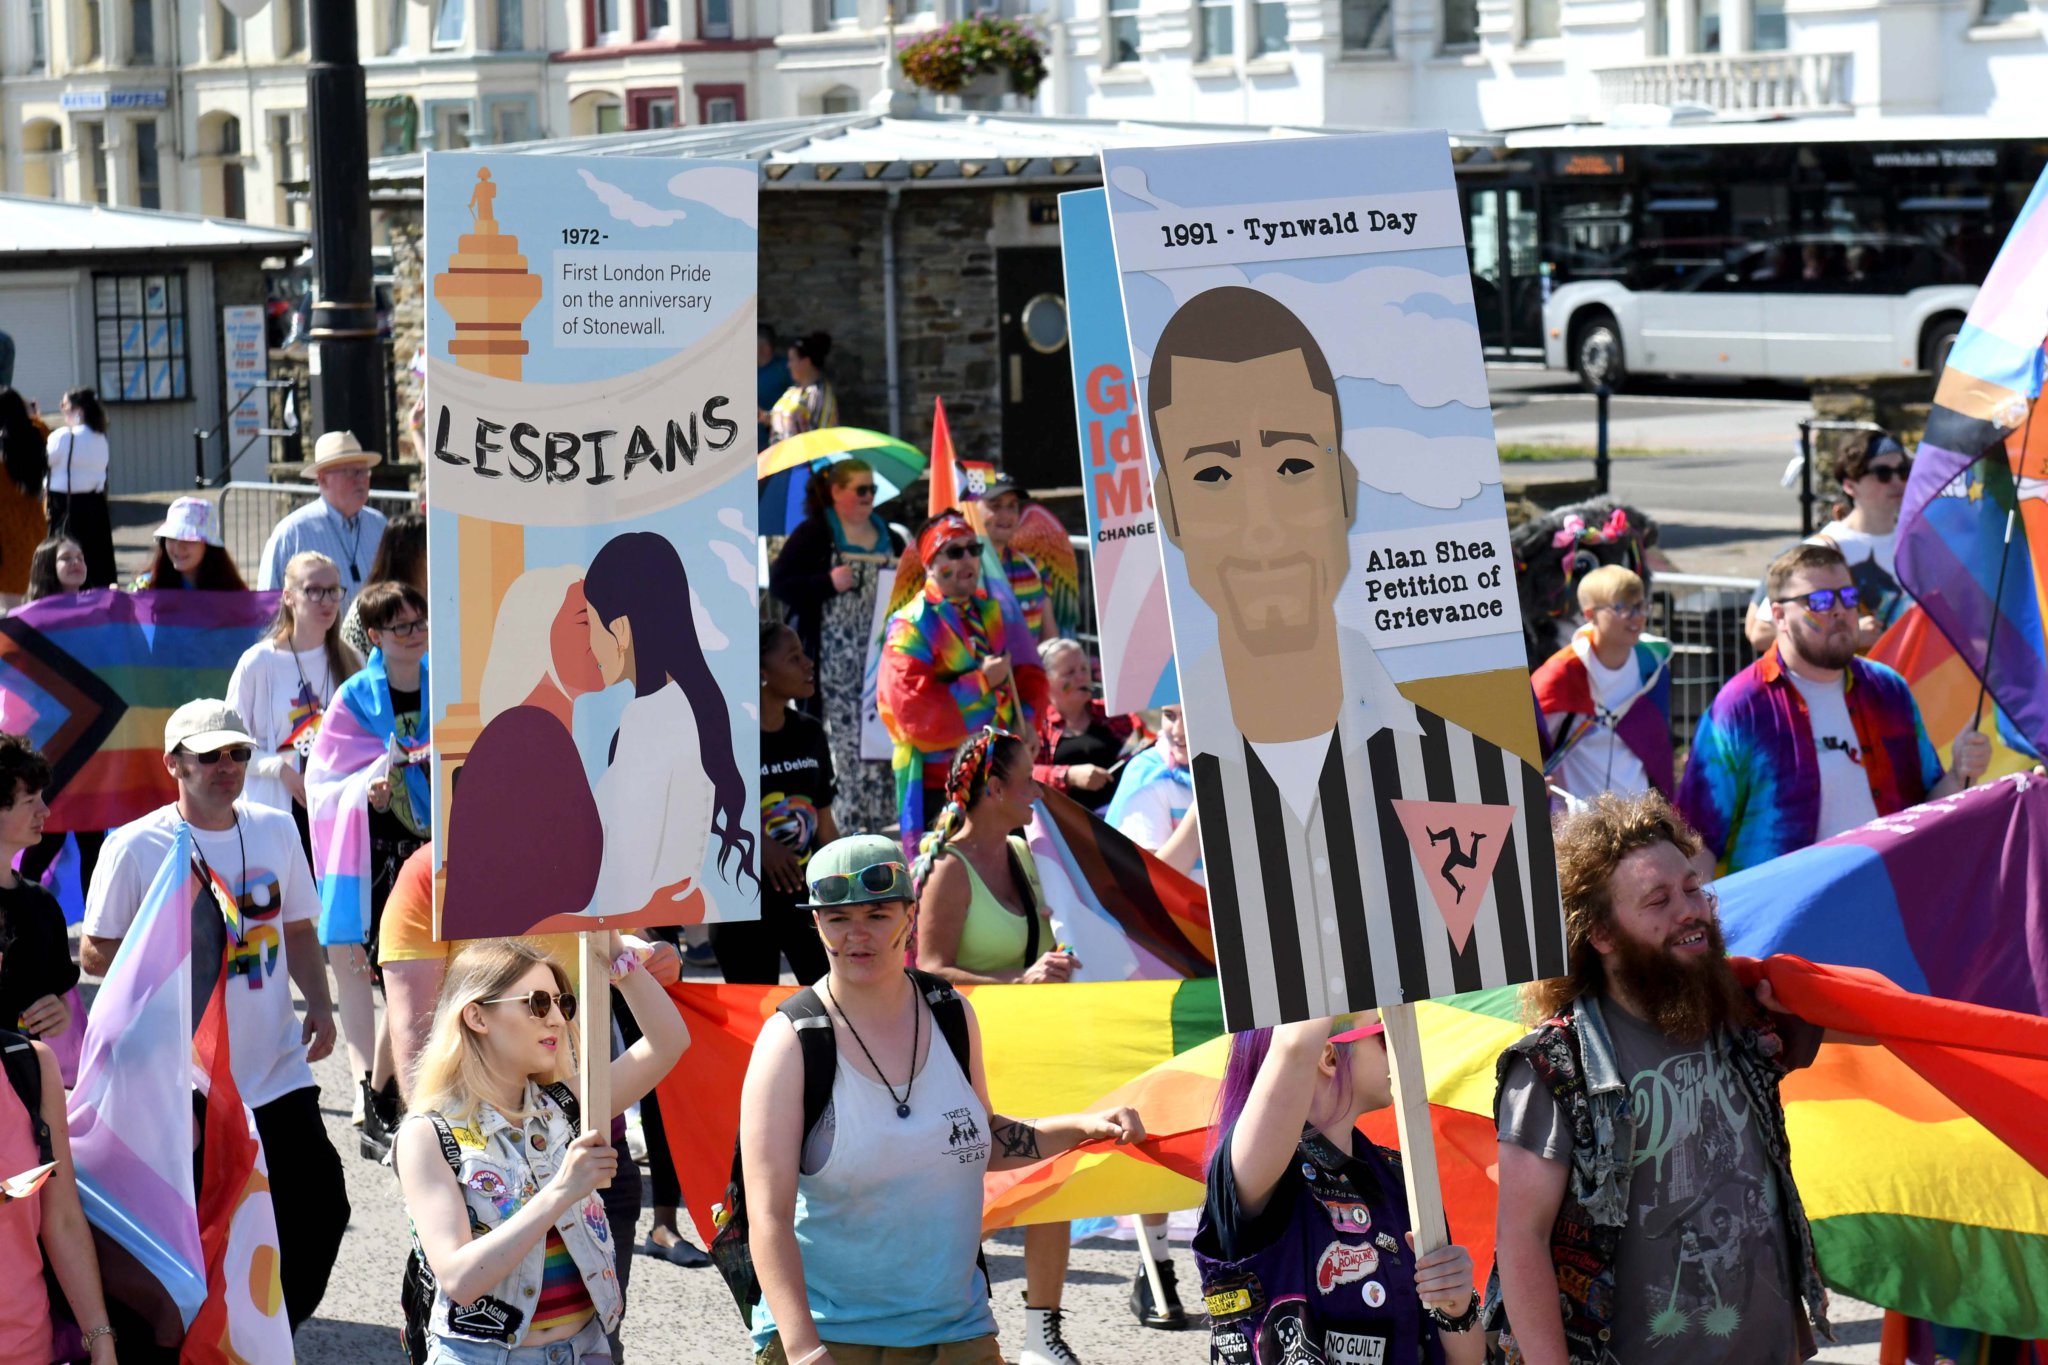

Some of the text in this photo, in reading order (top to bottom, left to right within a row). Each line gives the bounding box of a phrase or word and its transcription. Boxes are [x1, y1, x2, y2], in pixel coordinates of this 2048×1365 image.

[1161, 222, 1218, 247] 1991
[1244, 211, 1359, 246] Tynwald
[1367, 209, 1418, 235] Day
[562, 263, 711, 282] First London Pride
[562, 290, 712, 312] on the anniversary
[562, 316, 665, 335] of Stonewall.
[1085, 363, 1138, 415] G
[434, 395, 738, 485] LESBIANS
[1088, 414, 1142, 467] Id
[1093, 467, 1154, 519] M
[1097, 521, 1156, 543] CHANGE
[1366, 541, 1496, 573] Alan Shea
[1365, 564, 1501, 602] Petition of
[1374, 599, 1503, 631] Grievance
[552, 1085, 574, 1107] LOVE
[942, 1107, 971, 1120] TREES
[959, 1150, 985, 1164] SEAS
[486, 1304, 509, 1323] AGAIN
[1326, 1334, 1381, 1358] NO GUILT.
